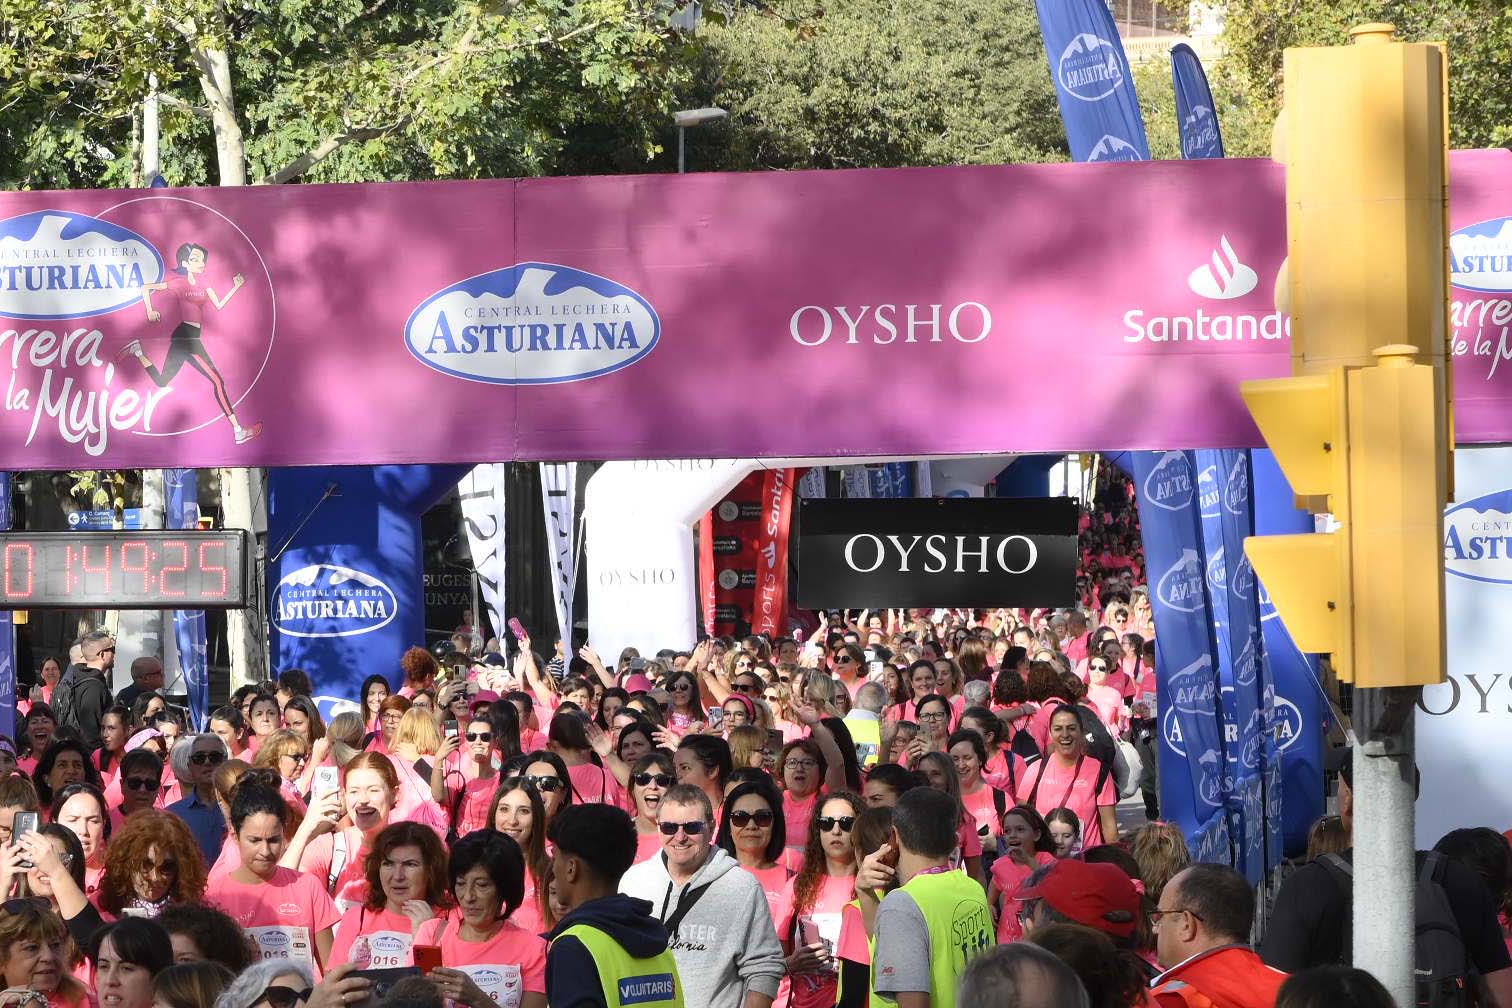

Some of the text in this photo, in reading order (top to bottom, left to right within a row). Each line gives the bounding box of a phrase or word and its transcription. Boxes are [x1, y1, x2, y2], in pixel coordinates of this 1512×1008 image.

[464, 302, 633, 318] CENTRAL LECHERA
[789, 301, 993, 346] OYSHO
[1122, 309, 1291, 343] Santand
[424, 309, 641, 355] ASTURIANA
[4, 370, 30, 411] la
[24, 361, 174, 457] Mujer
[4, 541, 228, 597] 01:49:25
[844, 533, 1039, 575] OYSHO
[274, 596, 389, 622] ASTURIANA
[951, 906, 985, 947] Sport
[373, 955, 399, 966] 016
